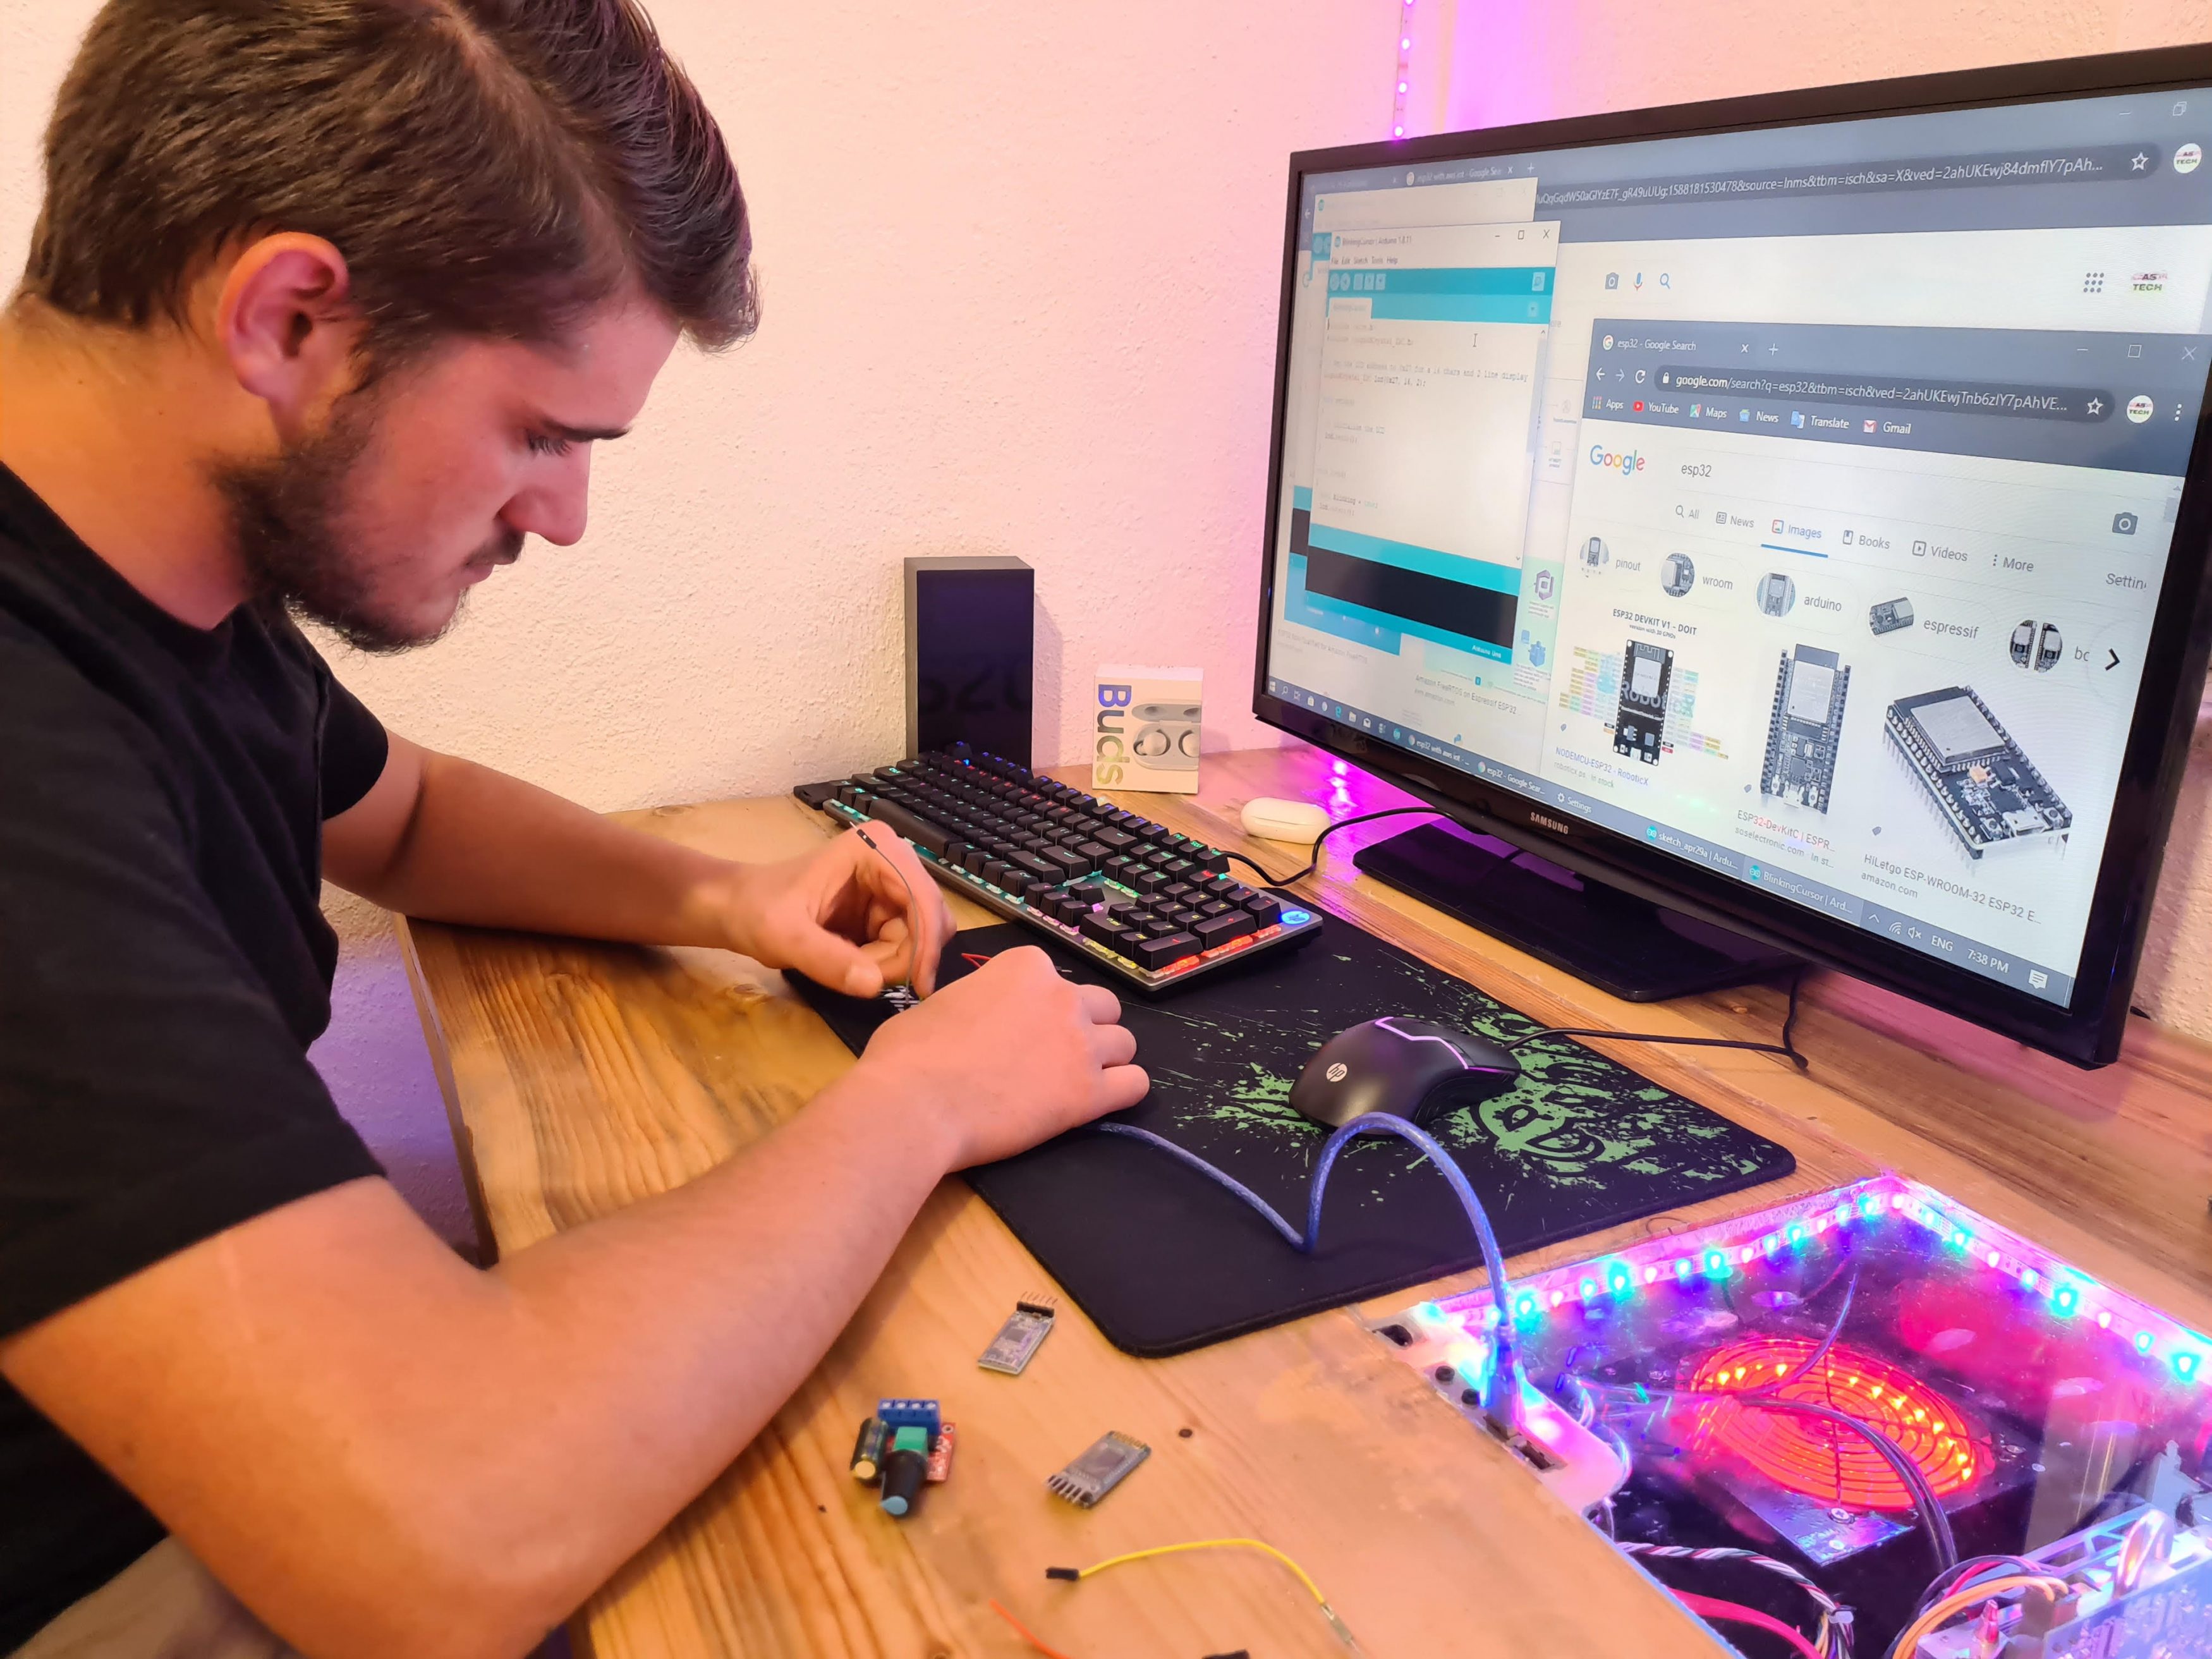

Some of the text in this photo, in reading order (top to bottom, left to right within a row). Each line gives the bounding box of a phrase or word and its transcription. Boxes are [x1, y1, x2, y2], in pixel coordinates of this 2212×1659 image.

[1387, 257, 1398, 265] Help
[1617, 339, 1638, 350] esp32
[1644, 340, 1670, 351] Google
[1672, 341, 1696, 351] Search
[1502, 372, 1528, 383] display
[1606, 400, 1911, 435] Apps YouTube Maps News Translate Gmail
[1590, 444, 1645, 475] Google
[1681, 464, 1711, 478] esp32
[1688, 509, 1699, 520] All
[1730, 515, 1754, 528] News
[1788, 524, 1822, 539] Images
[1859, 535, 1890, 549] Books
[1931, 546, 1968, 562] Videos
[2003, 557, 2034, 572] More
[1615, 558, 1641, 572] pinout
[1702, 576, 1733, 590] wroom
[1804, 595, 1842, 612] arduino
[1923, 618, 1980, 639] espressif
[1613, 609, 1633, 621] ESP32
[1634, 614, 1660, 627] DEVKIT
[1662, 619, 1670, 629] V1
[1678, 624, 1698, 635] DOIT
[1497, 701, 1517, 715] ESP32
[1096, 683, 1132, 786] Buds
[1486, 767, 1503, 779] esp32
[1507, 774, 1528, 789] Google
[1555, 746, 1612, 773] NODEMCU-ESP32
[1617, 768, 1649, 786] RoboticX
[1567, 795, 1592, 814] Settings
[1529, 811, 1569, 834] SAMSUNG
[1737, 810, 1799, 839] ESP32-DevKitC
[1658, 832, 1708, 858] sketch_apr29a
[1763, 871, 1824, 902] BlinkingCursor
[1861, 871, 1919, 899] amazon.com
[1864, 853, 1902, 875] HiLetgo
[1904, 867, 1986, 904] ESP-WROOM-32
[1988, 896, 2024, 918] ESP32
[1931, 935, 1954, 952] ENG
[1967, 948, 2010, 974] 7:38 PM
[1327, 1062, 1347, 1082] hp
